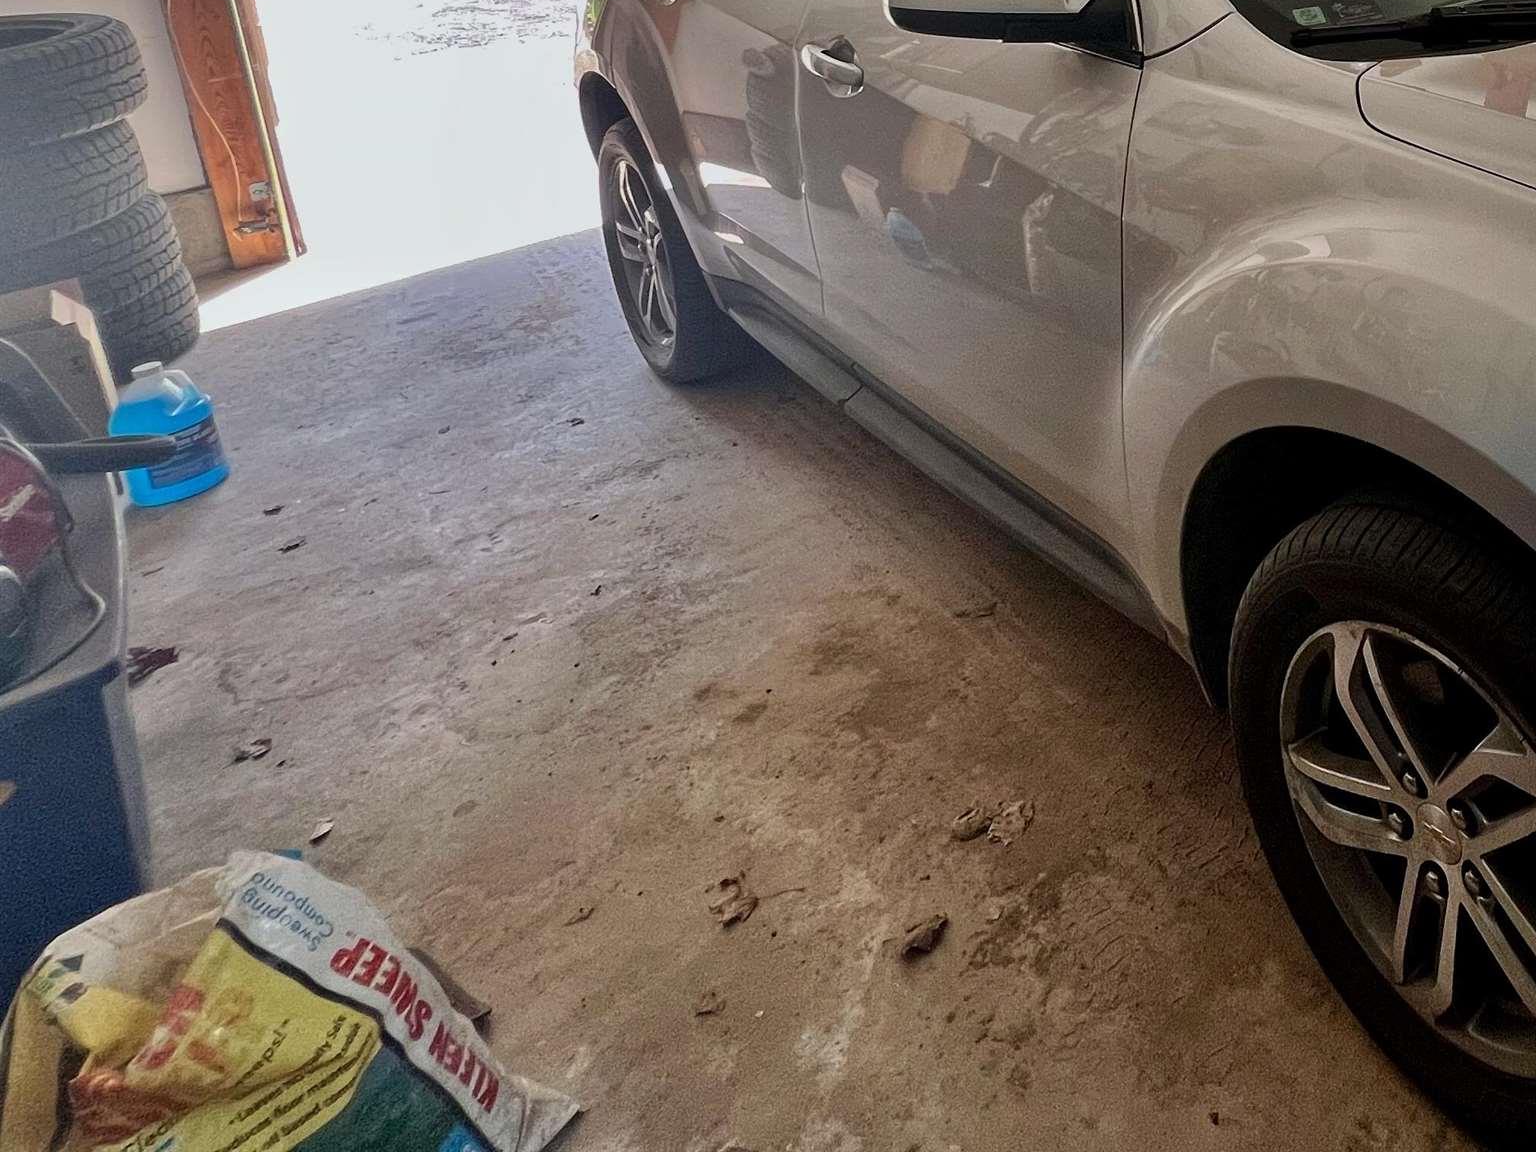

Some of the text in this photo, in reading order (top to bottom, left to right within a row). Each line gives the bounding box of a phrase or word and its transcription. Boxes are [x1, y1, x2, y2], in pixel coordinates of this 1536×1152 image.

[250, 870, 334, 939] Compound
[328, 936, 433, 1042] SWEEP
[428, 1019, 500, 1115] KLEEN
